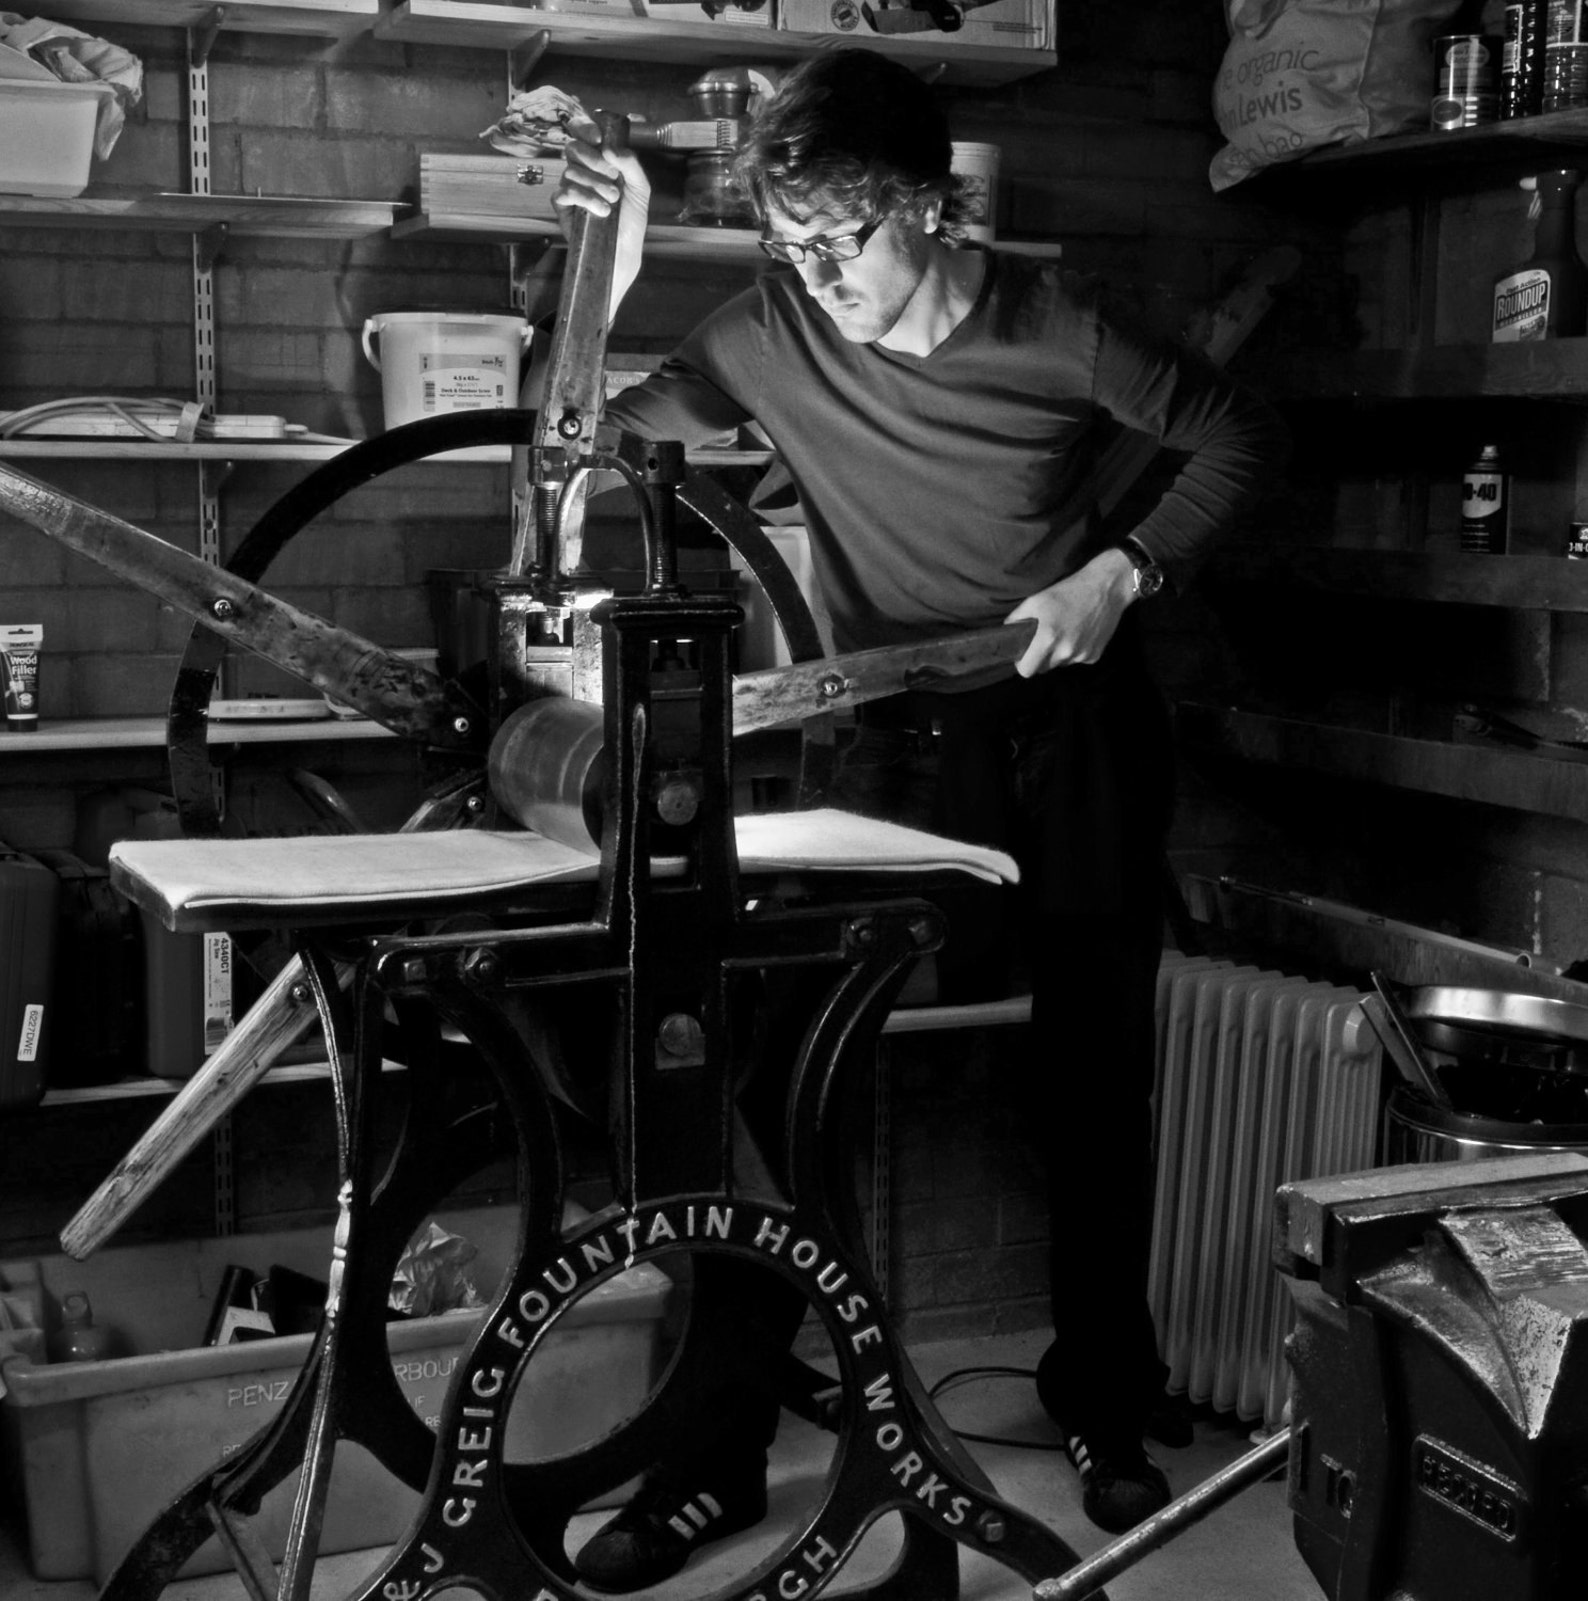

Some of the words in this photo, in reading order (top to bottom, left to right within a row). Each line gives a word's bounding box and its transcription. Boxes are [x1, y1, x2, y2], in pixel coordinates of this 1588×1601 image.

[1237, 49, 1320, 87] organic
[1239, 80, 1303, 126] Lewis
[1497, 282, 1546, 321] ROUNDUP
[1462, 483, 1497, 501] D-40
[10, 654, 38, 665] Wood
[12, 664, 37, 675] Filler
[22, 1010, 39, 1056] 6227DWE
[227, 1380, 297, 1409] PENZ
[420, 1541, 445, 1574] J
[442, 1367, 505, 1528] GREIG
[497, 1205, 733, 1349] FOUNTAIN
[754, 1216, 883, 1355] HOUSE
[863, 1372, 972, 1526] WORKS
